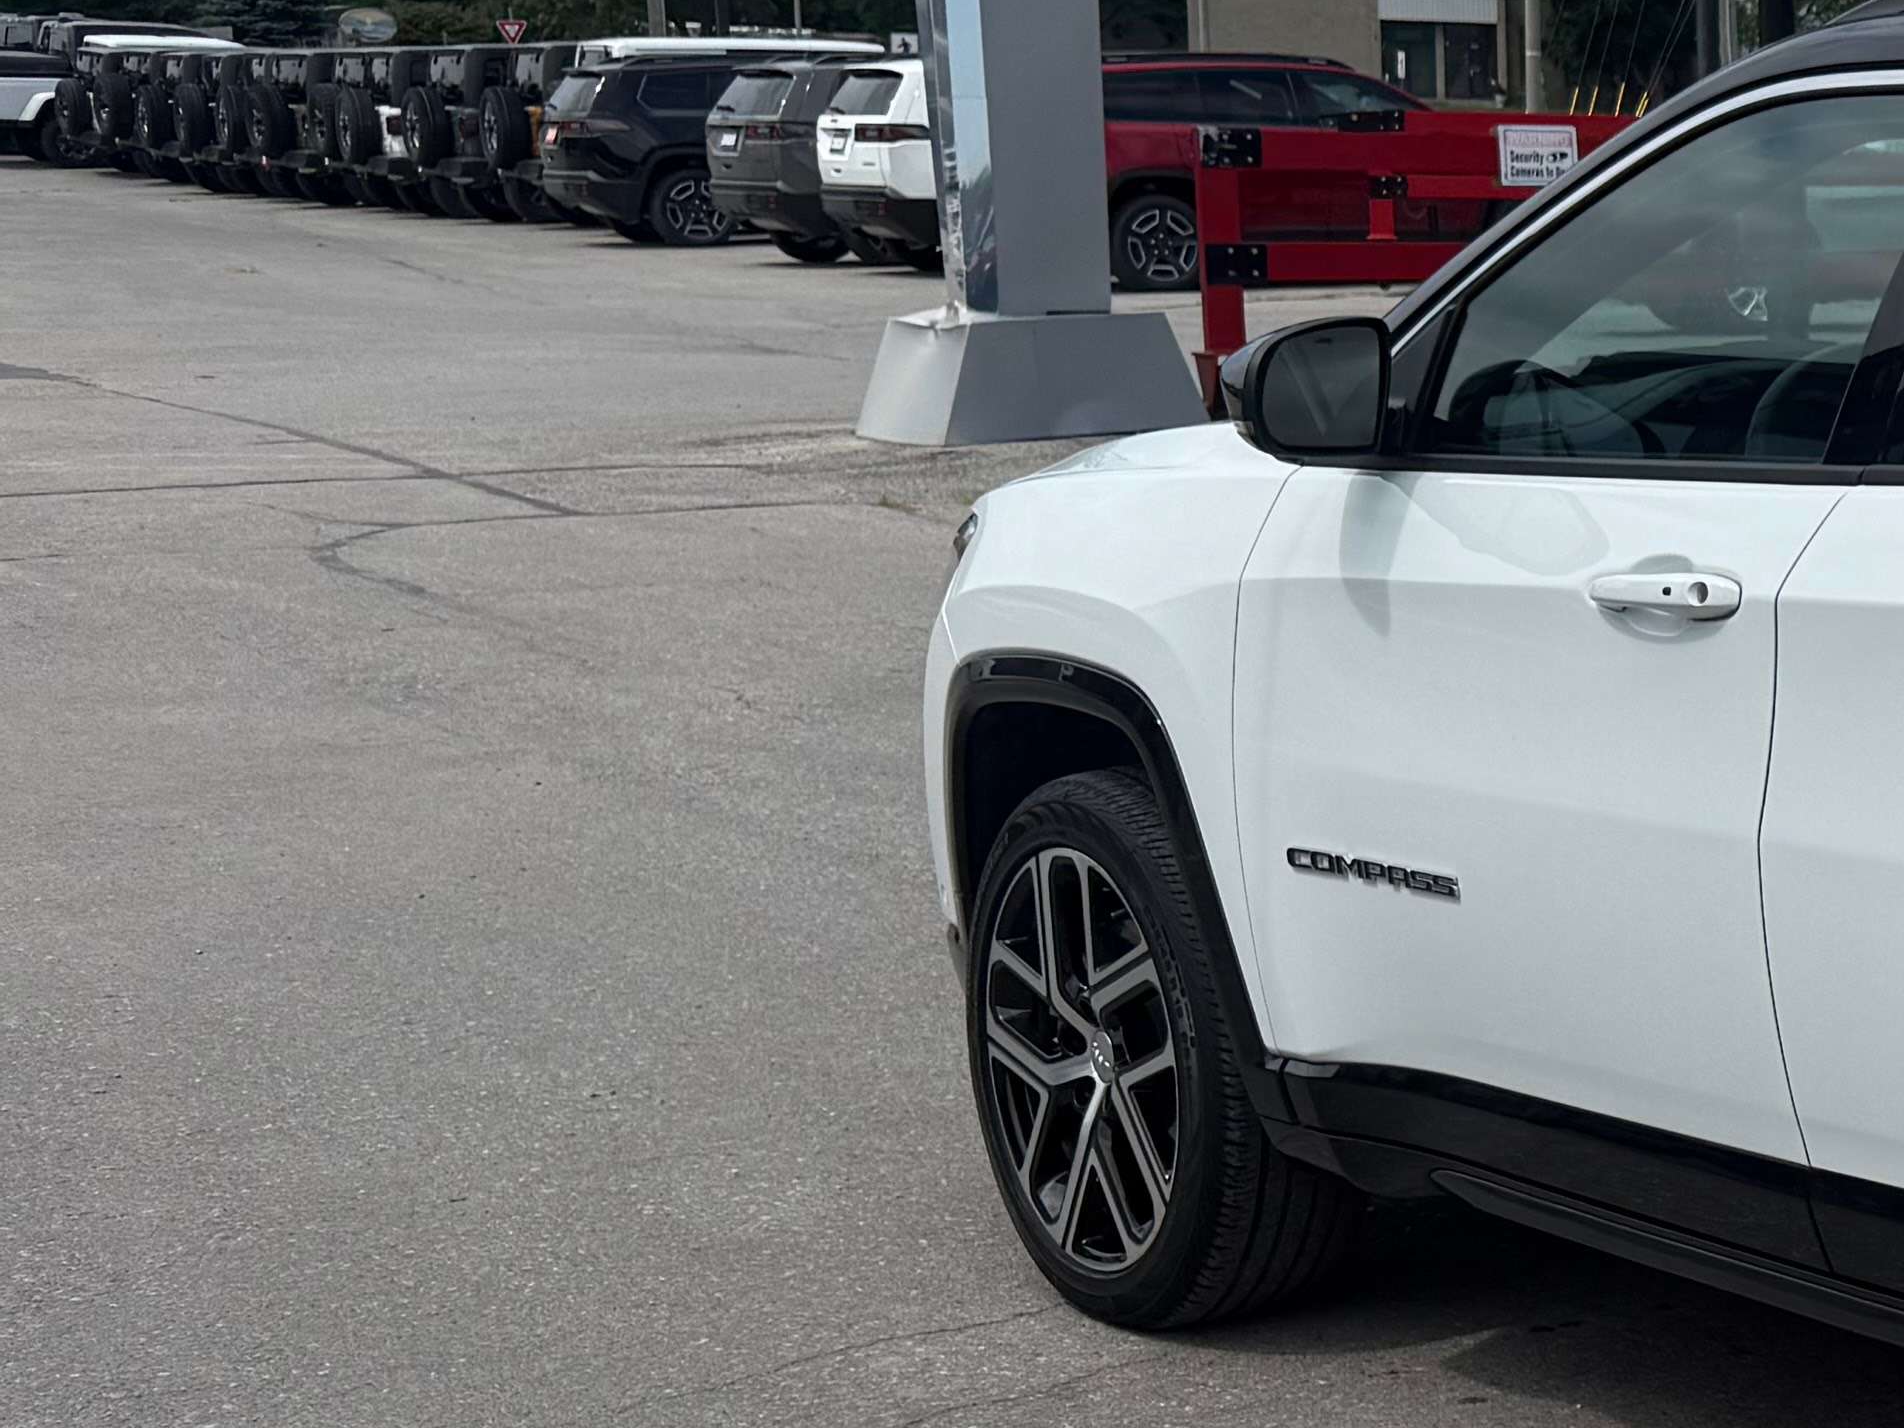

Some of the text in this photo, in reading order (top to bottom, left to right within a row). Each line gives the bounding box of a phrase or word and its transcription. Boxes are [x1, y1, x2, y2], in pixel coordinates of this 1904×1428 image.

[1510, 149, 1545, 166] Security
[1511, 165, 1545, 178] Cameras
[1286, 847, 1461, 900] COMPASS
